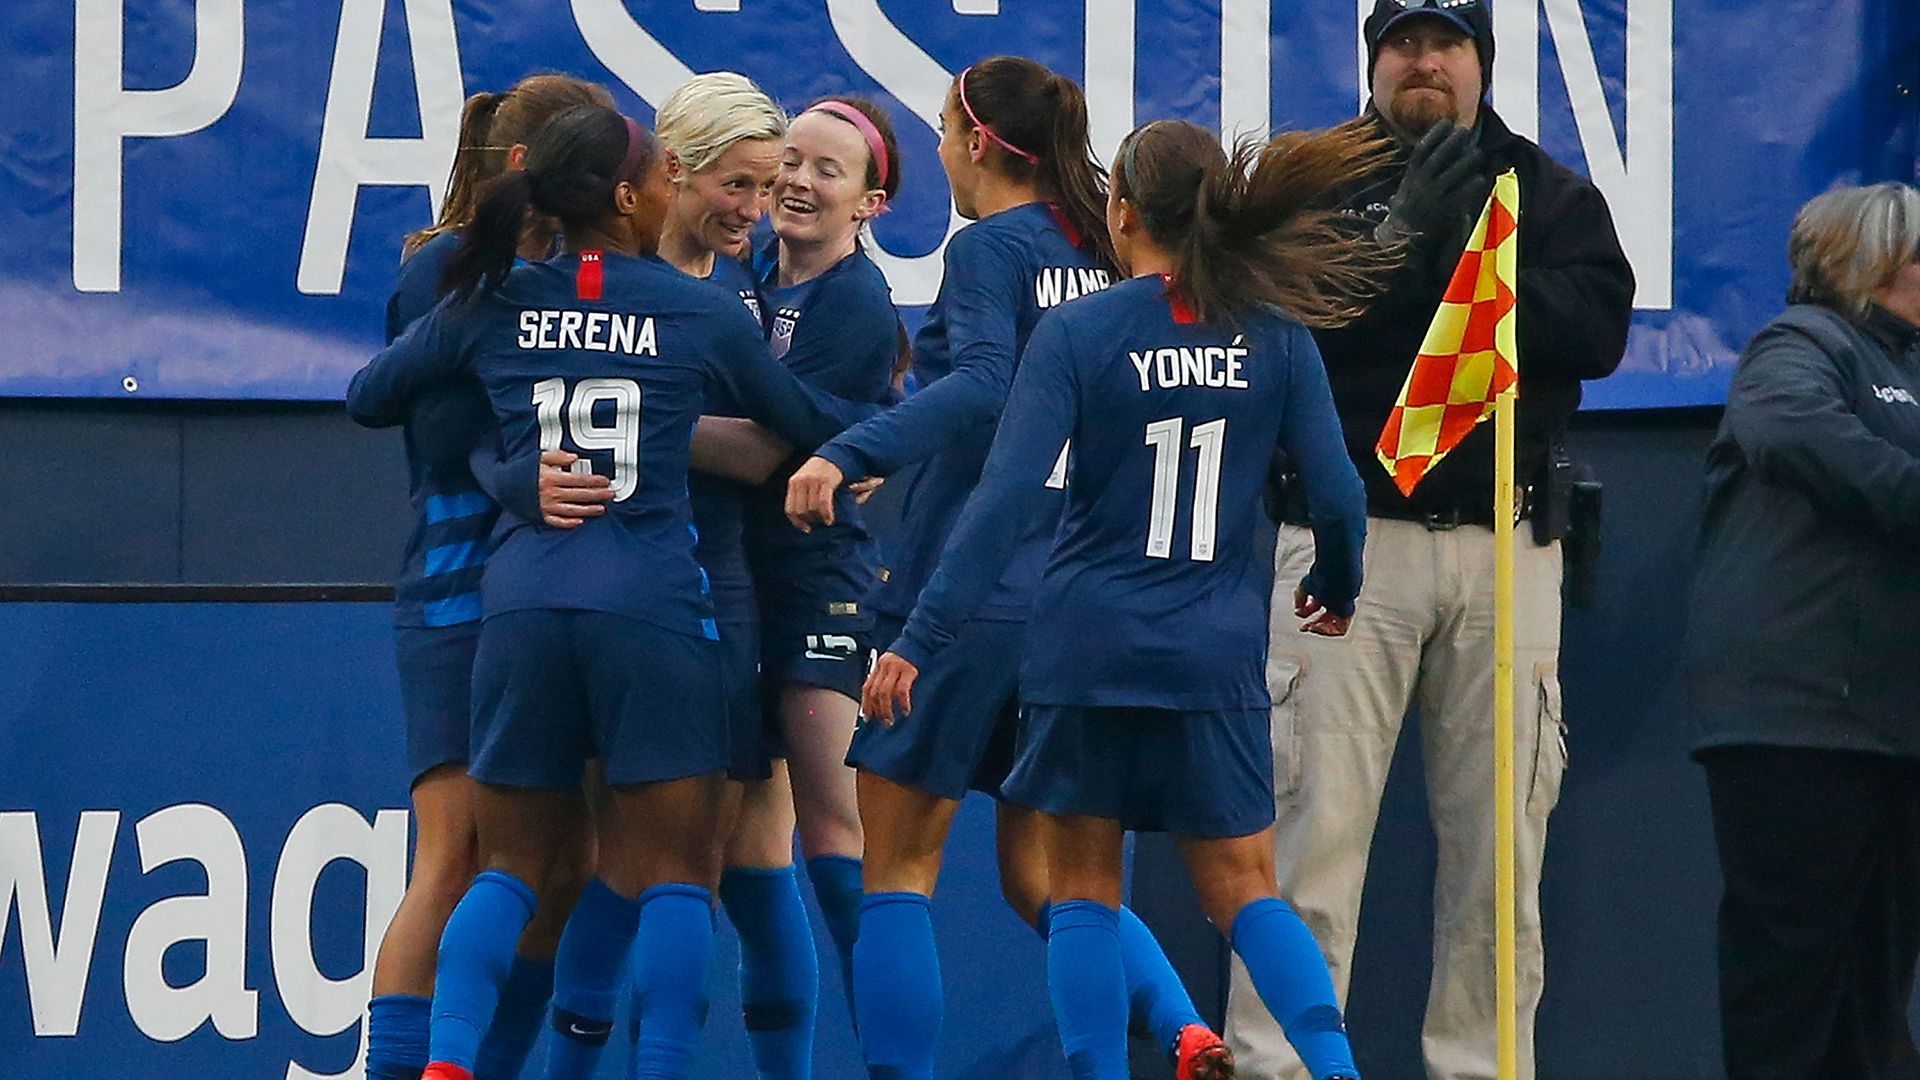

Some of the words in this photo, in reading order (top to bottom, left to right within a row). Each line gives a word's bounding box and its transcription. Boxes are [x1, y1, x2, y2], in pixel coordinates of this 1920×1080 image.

[73, 0, 1673, 310] PASIN
[518, 310, 658, 356] SERENA
[1128, 334, 1248, 391] YONCÉ
[532, 377, 642, 503] 19
[1145, 417, 1226, 561] 11
